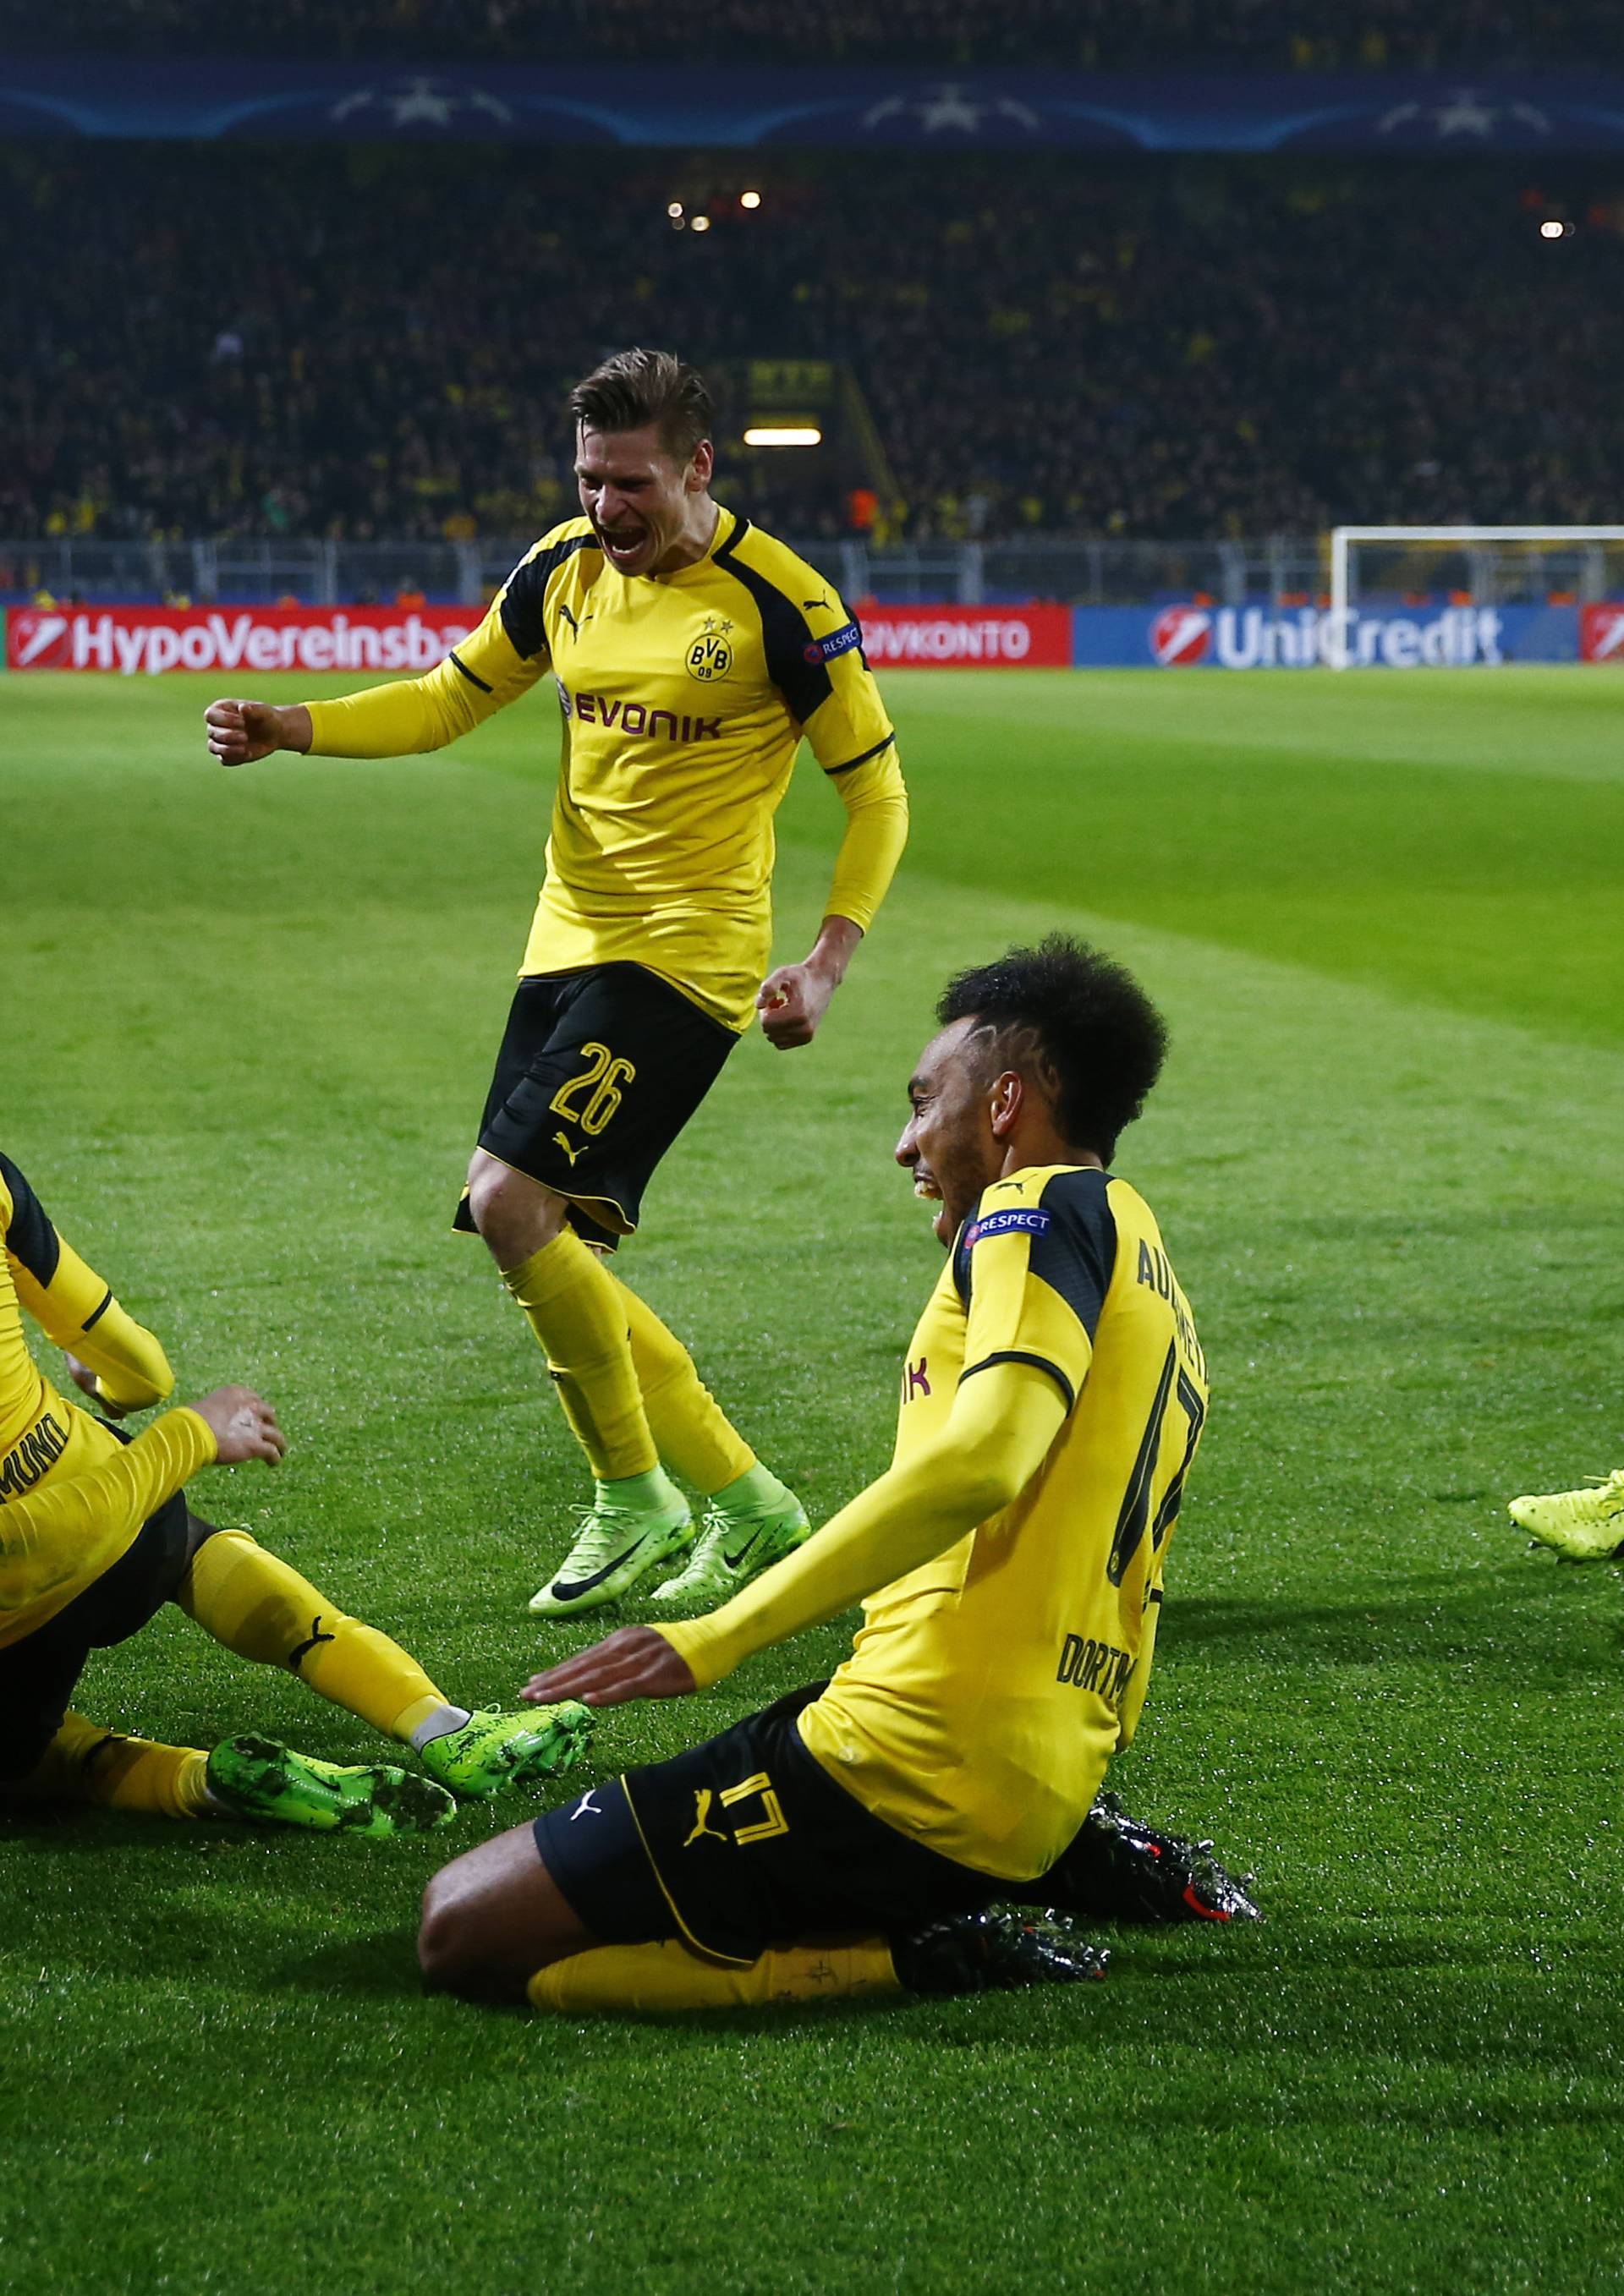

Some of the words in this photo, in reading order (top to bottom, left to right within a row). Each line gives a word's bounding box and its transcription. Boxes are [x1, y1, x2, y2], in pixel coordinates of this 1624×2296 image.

[690, 638, 727, 670] BVB
[1216, 606, 1504, 669] UniCredit
[698, 666, 712, 678] 09
[575, 693, 723, 742] EVONIK
[549, 1042, 636, 1136] 26
[979, 1214, 1050, 1233] RESPECT
[719, 1772, 790, 1846] 17
